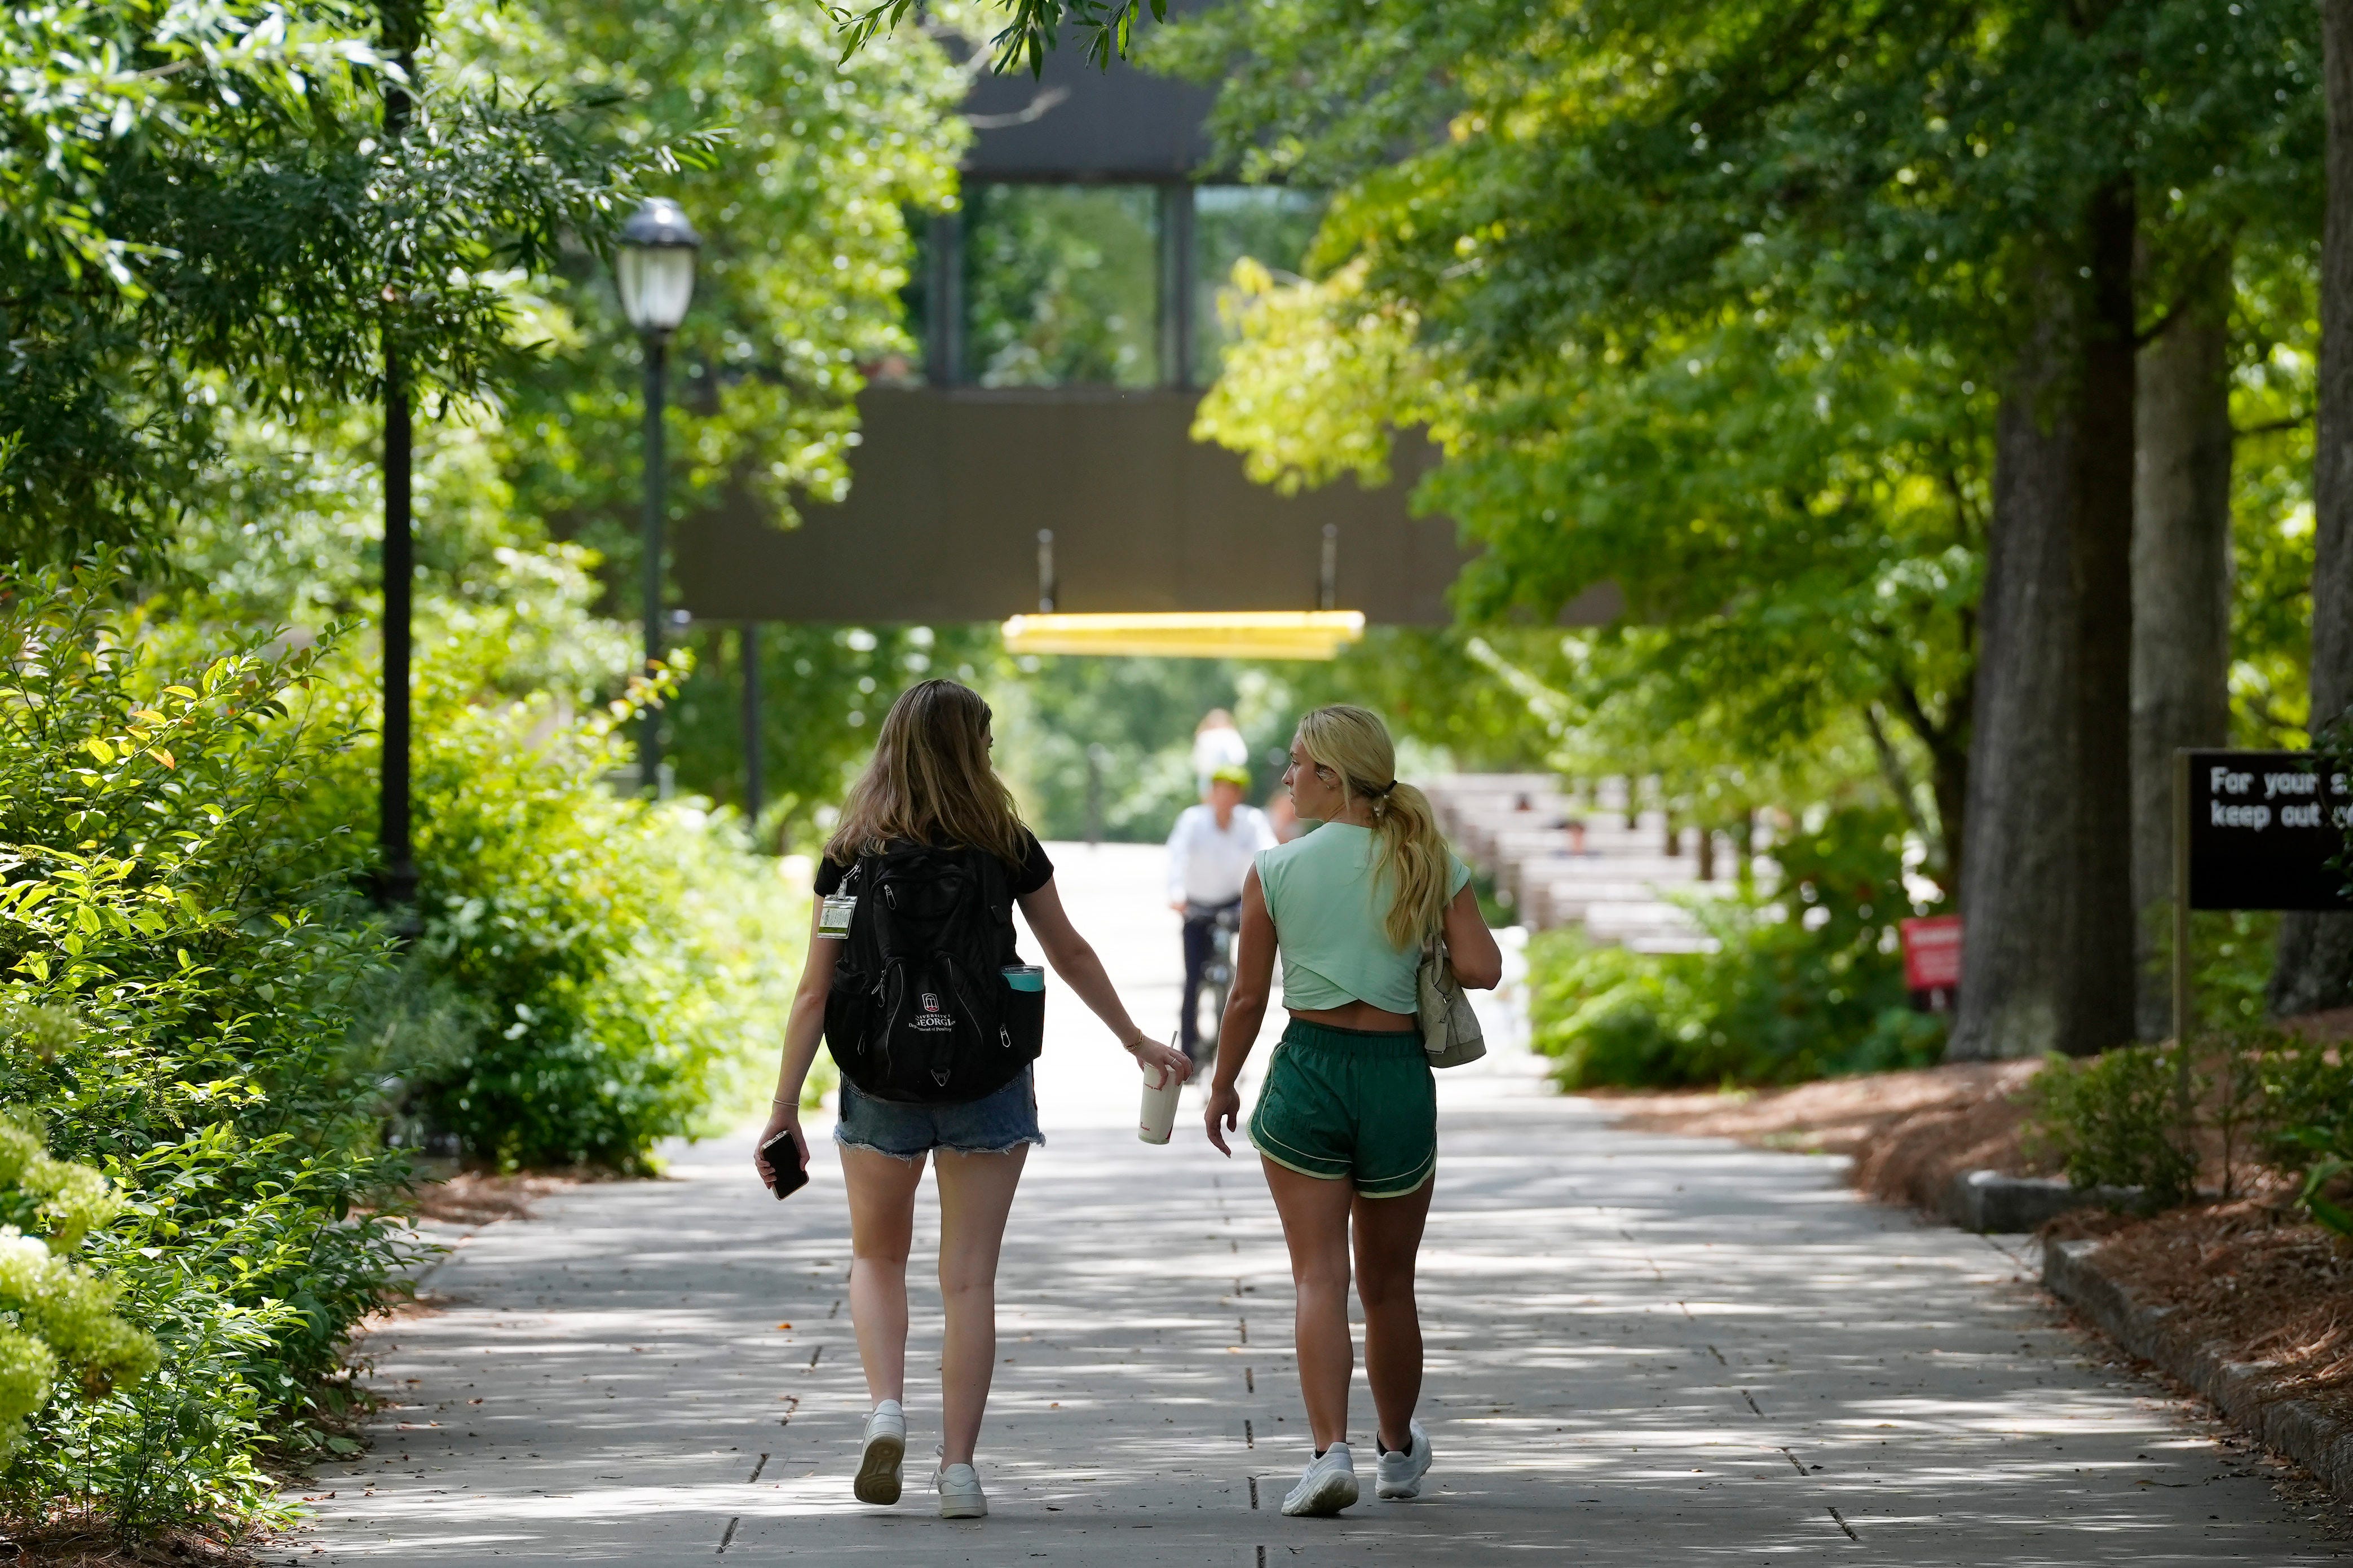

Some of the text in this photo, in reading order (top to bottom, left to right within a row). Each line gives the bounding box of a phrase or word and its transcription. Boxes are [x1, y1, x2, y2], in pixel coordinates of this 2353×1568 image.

[2210, 766, 2254, 794] For
[2263, 772, 2320, 800] your
[2210, 799, 2271, 832] keep
[2281, 801, 2322, 828] out
